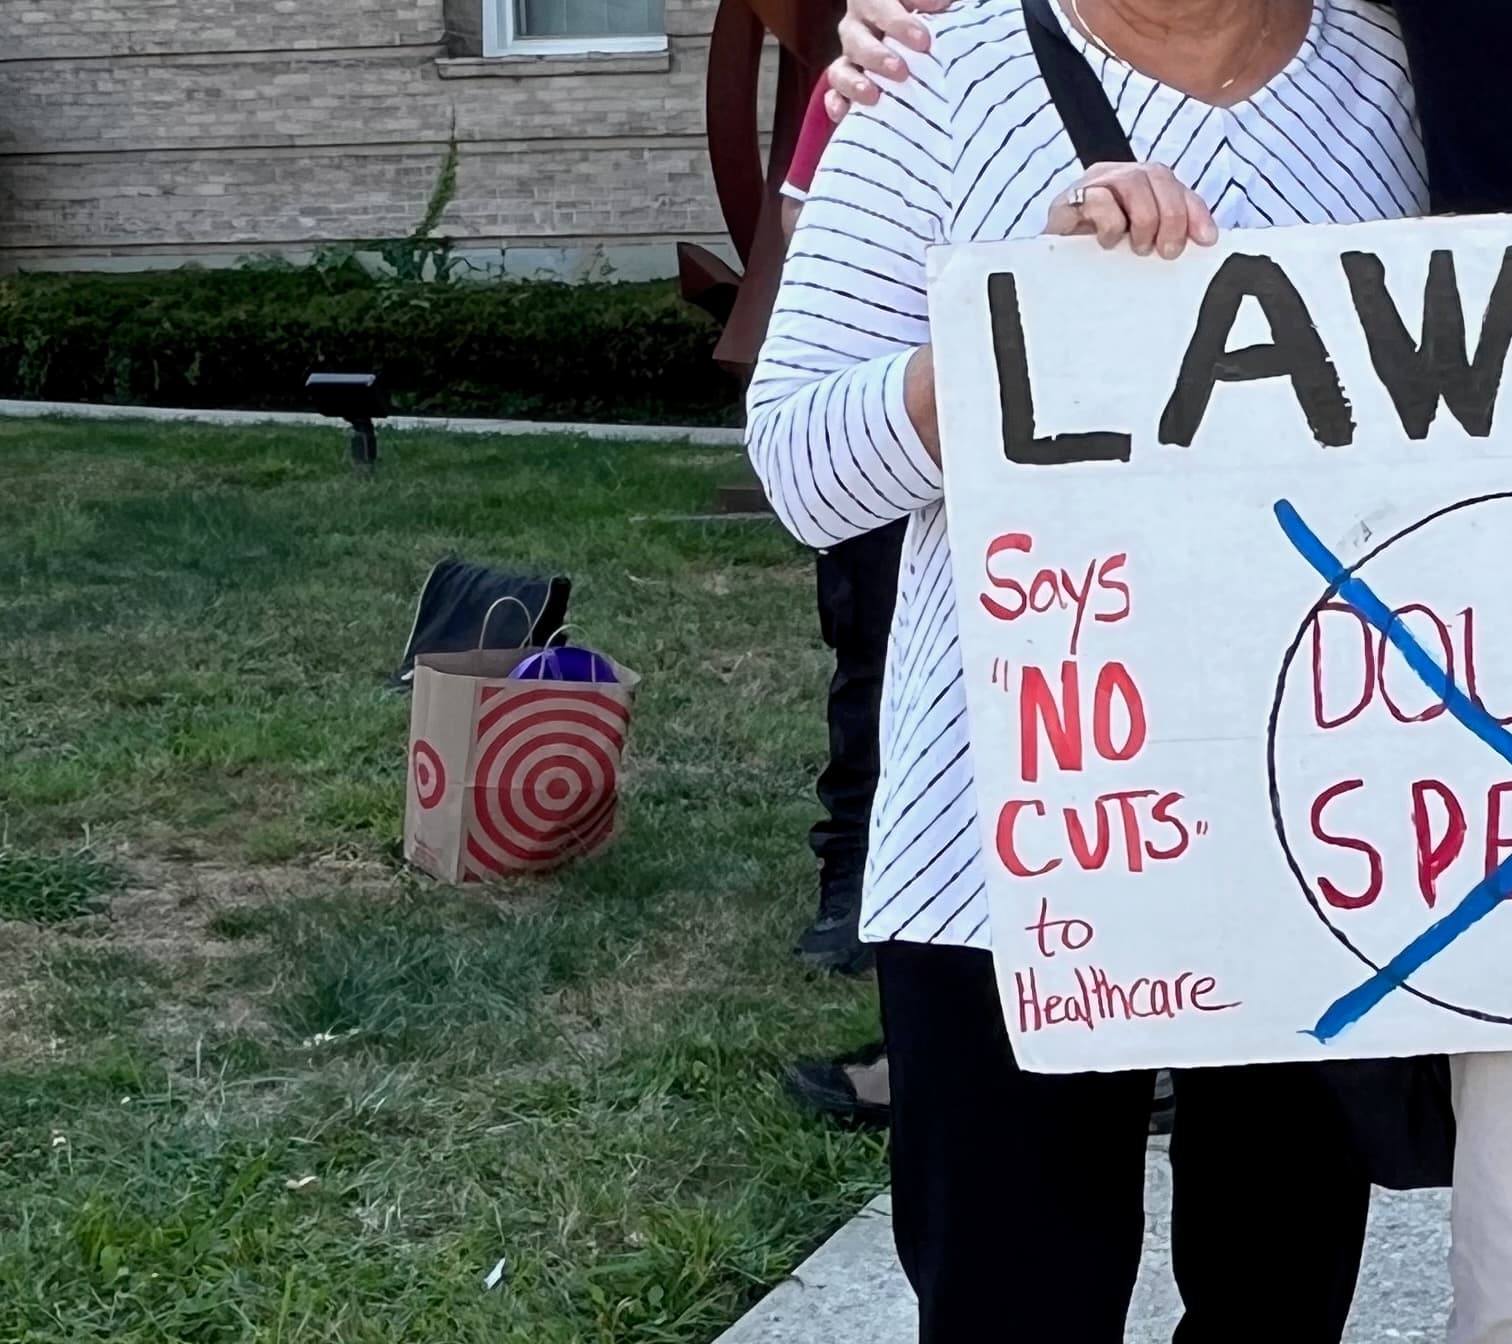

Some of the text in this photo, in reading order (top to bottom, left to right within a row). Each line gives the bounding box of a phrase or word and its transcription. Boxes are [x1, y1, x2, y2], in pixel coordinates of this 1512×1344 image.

[979, 533, 1132, 656] Says
[991, 660, 1147, 783] "NO
[995, 789, 1209, 877] CUTS"
[1025, 897, 1094, 957] to
[1015, 966, 1243, 1033] Healthcare
